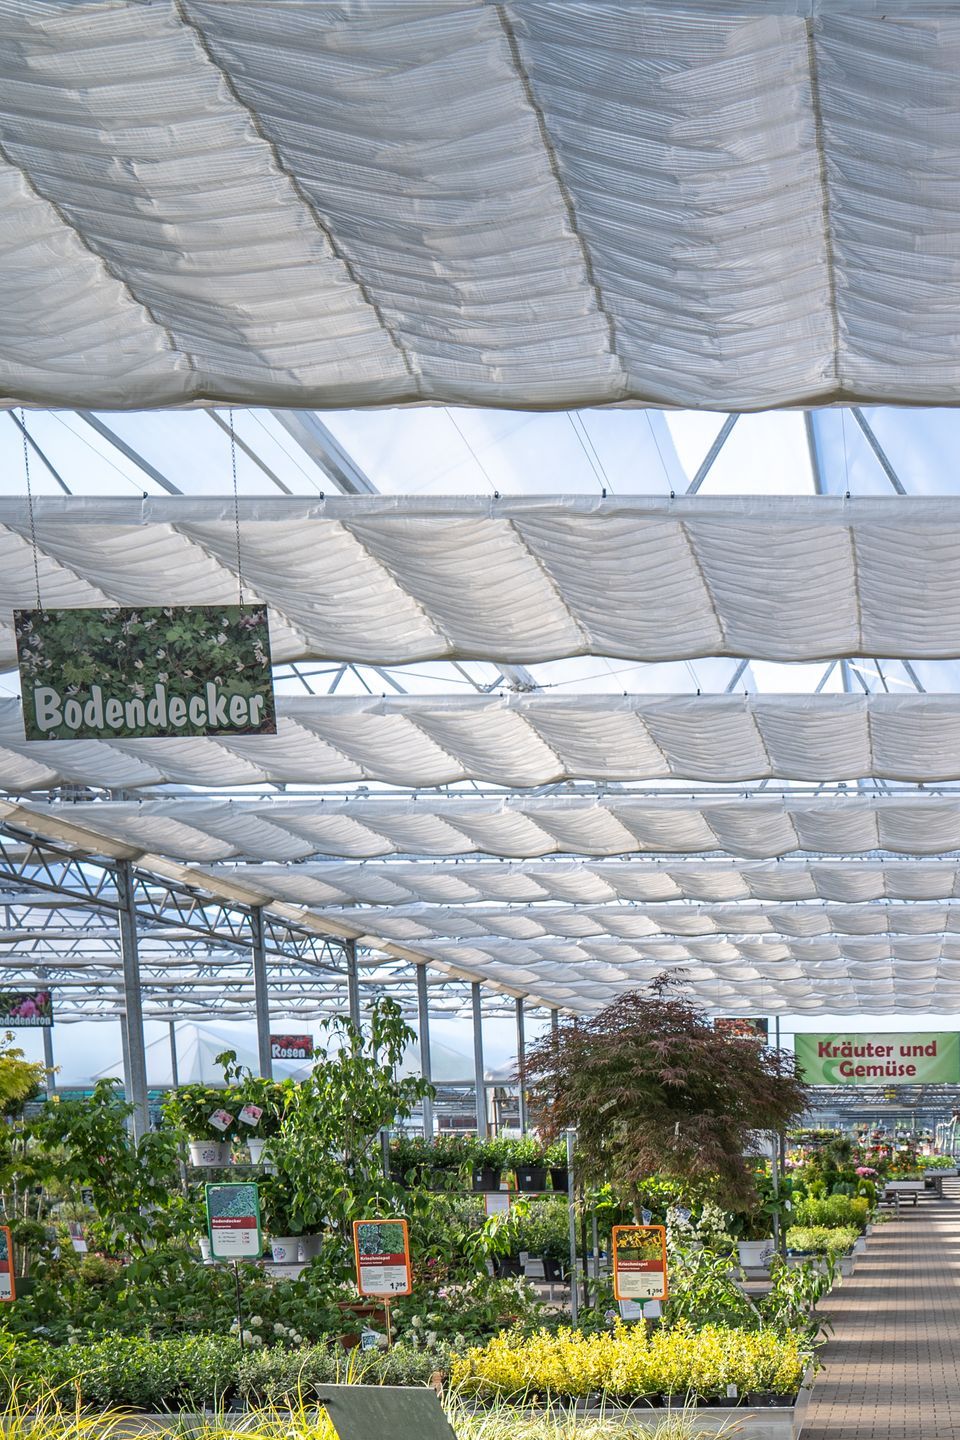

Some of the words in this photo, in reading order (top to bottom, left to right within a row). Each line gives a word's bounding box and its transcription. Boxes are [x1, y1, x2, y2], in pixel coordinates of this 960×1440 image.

[34, 682, 264, 732] Bodendecker
[271, 1043, 306, 1058] Rosen
[818, 1042, 893, 1058] Kräuter
[900, 1040, 937, 1057] und
[839, 1061, 917, 1077] Gemüse
